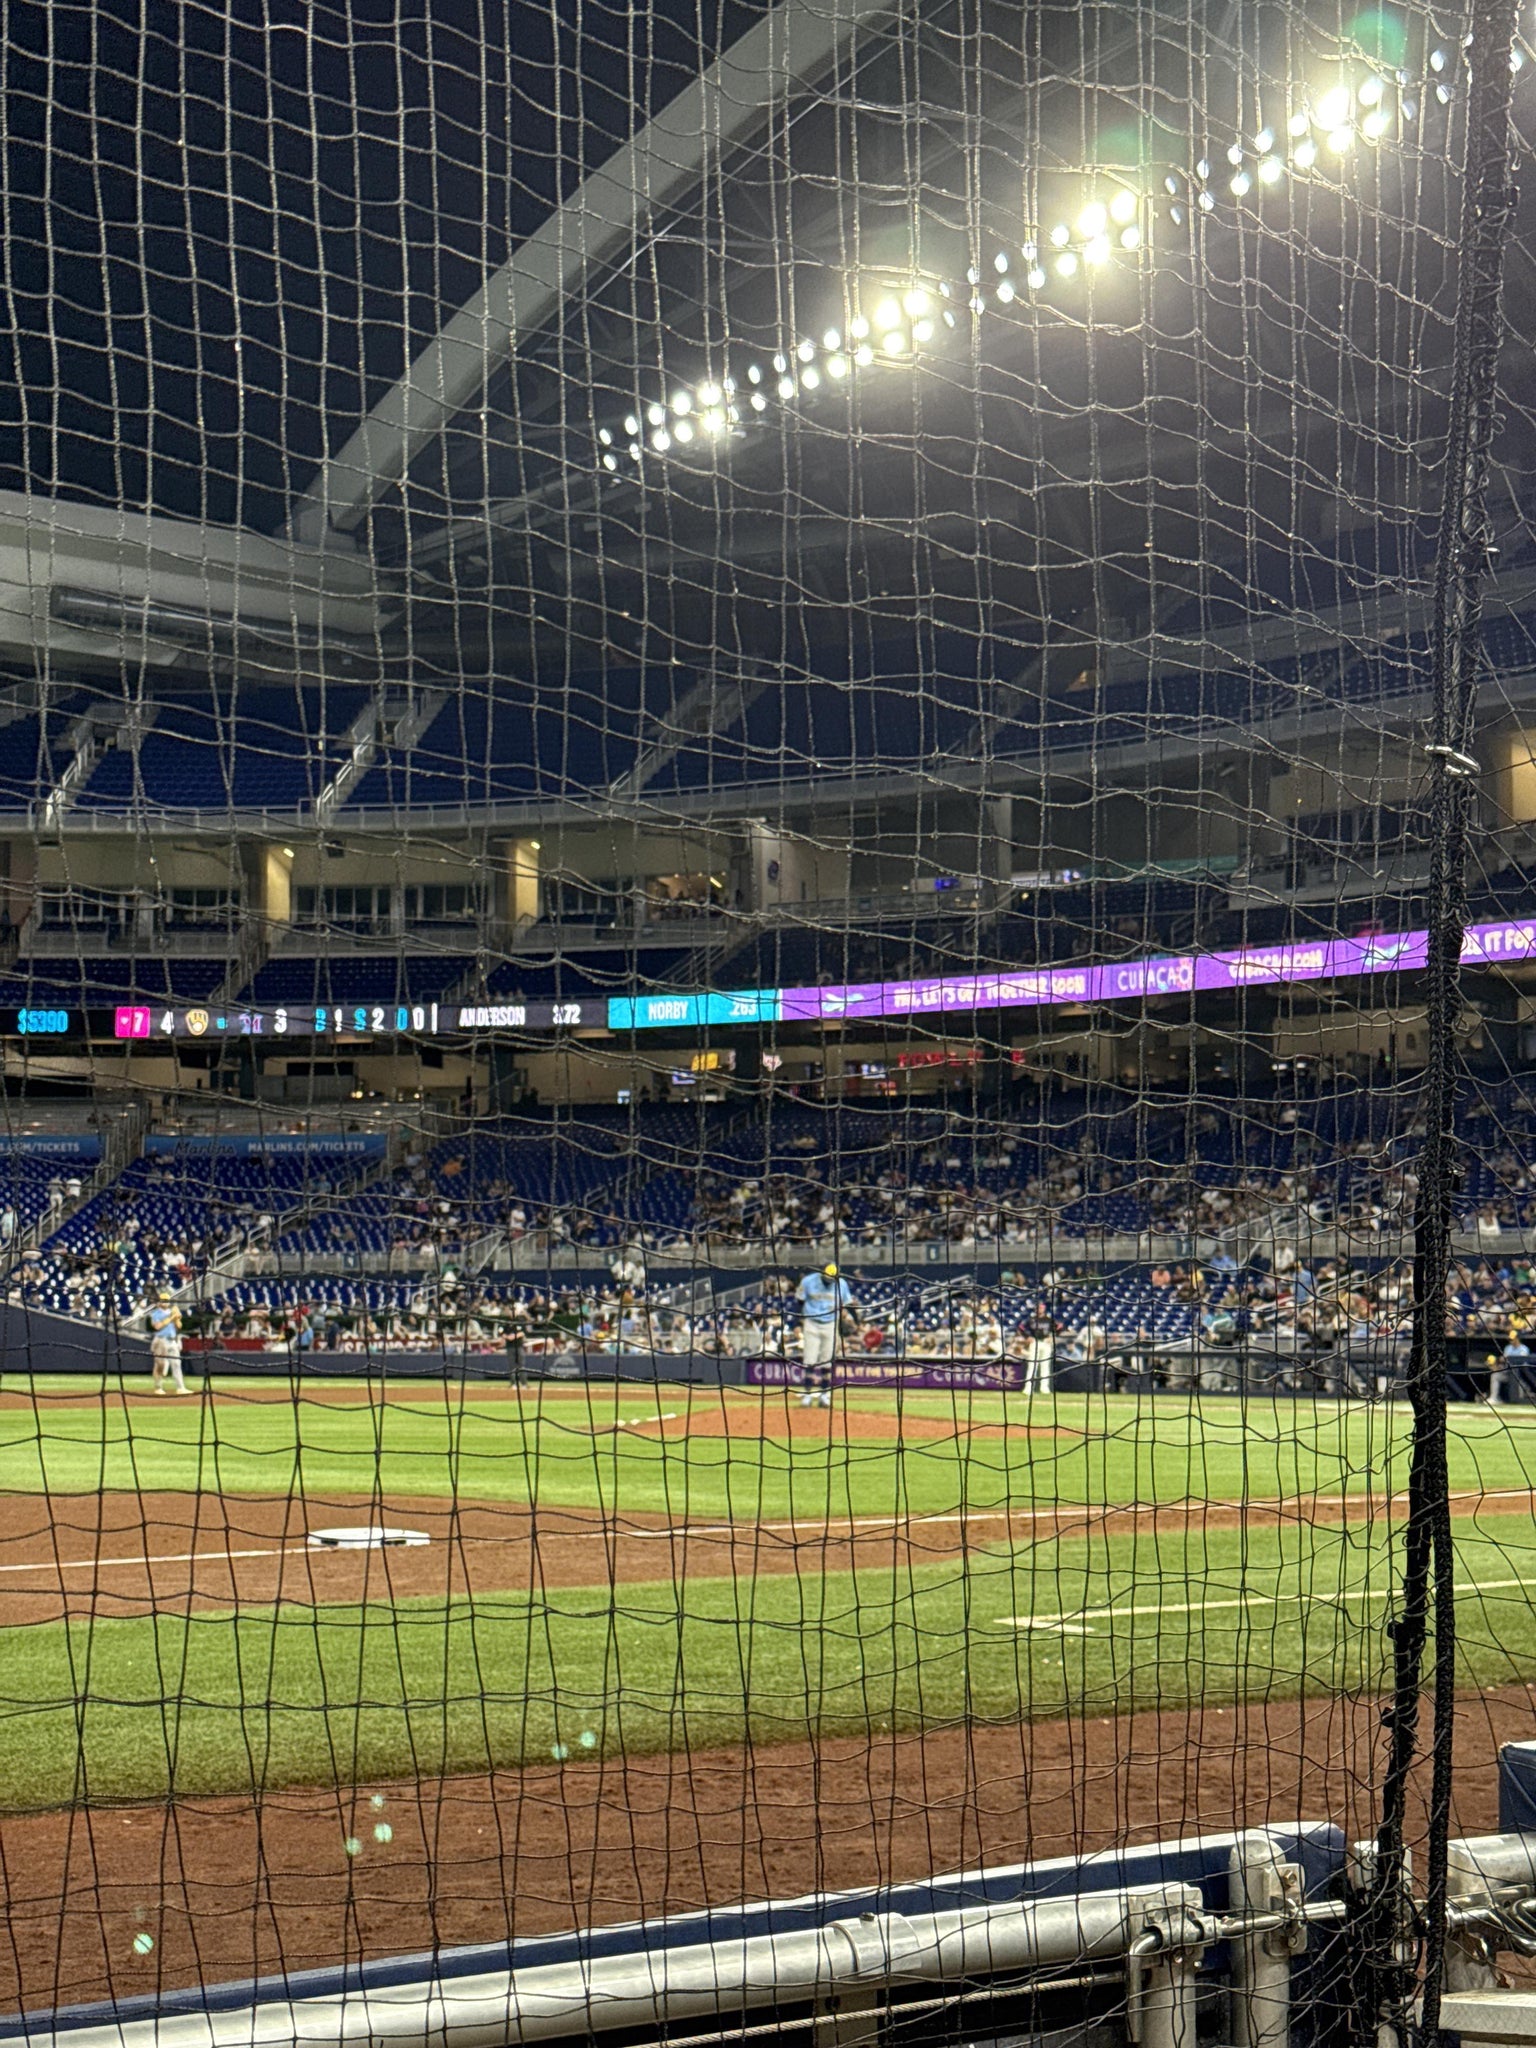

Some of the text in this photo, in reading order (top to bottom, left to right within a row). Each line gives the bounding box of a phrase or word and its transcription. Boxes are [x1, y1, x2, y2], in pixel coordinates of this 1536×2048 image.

[1485, 930, 1502, 952] IT
[1052, 975, 1086, 996] SOON
[134, 1011, 144, 1033] 7
[160, 1011, 173, 1034] 4
[274, 1008, 288, 1033] 3
[372, 1007, 385, 1032] 2
[459, 1001, 526, 1027] ANDERSON
[648, 1001, 689, 1021] NORBY
[248, 1141, 366, 1153] MARLINS.COM/TICKETS
